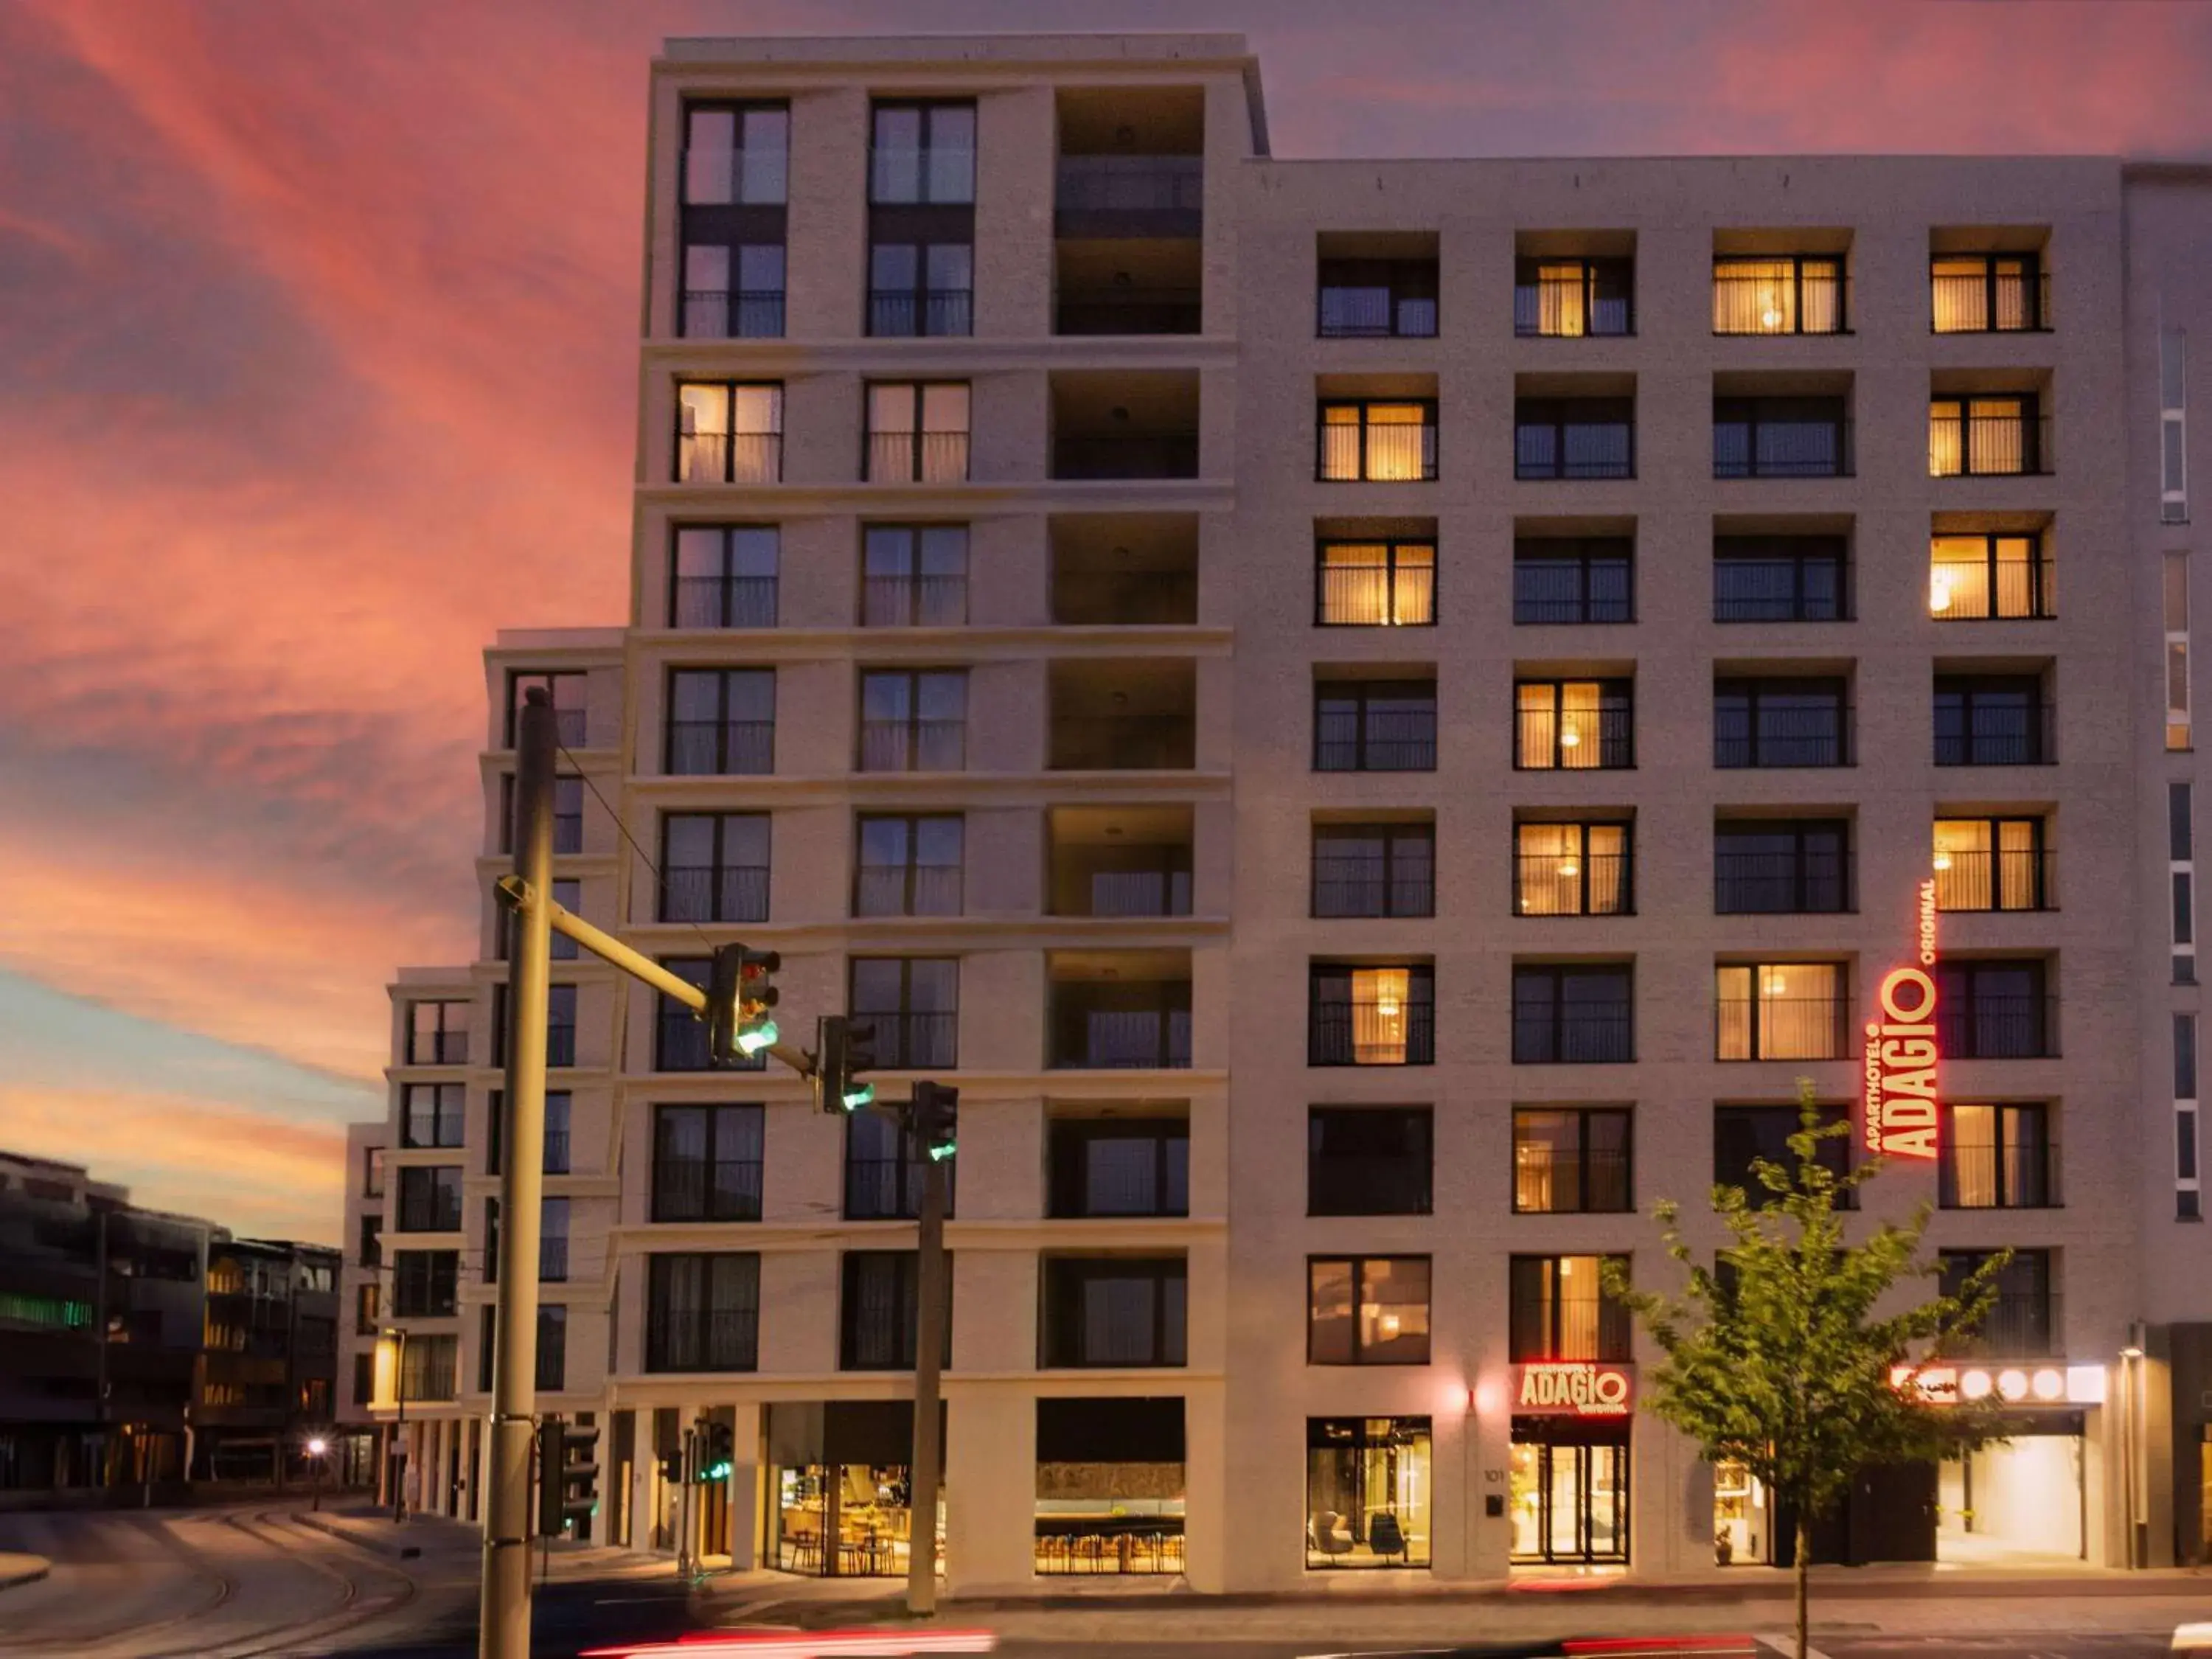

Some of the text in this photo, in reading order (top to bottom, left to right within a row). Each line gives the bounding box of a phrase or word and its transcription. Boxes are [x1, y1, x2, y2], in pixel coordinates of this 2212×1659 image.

[1920, 878, 1935, 966] ORIGINAL
[1865, 1038, 1881, 1152] APARTHOTEL
[1881, 967, 1938, 1158] ADAGIO
[1520, 1371, 1627, 1405] ADAGIO
[1484, 1470, 1504, 1483] 101
